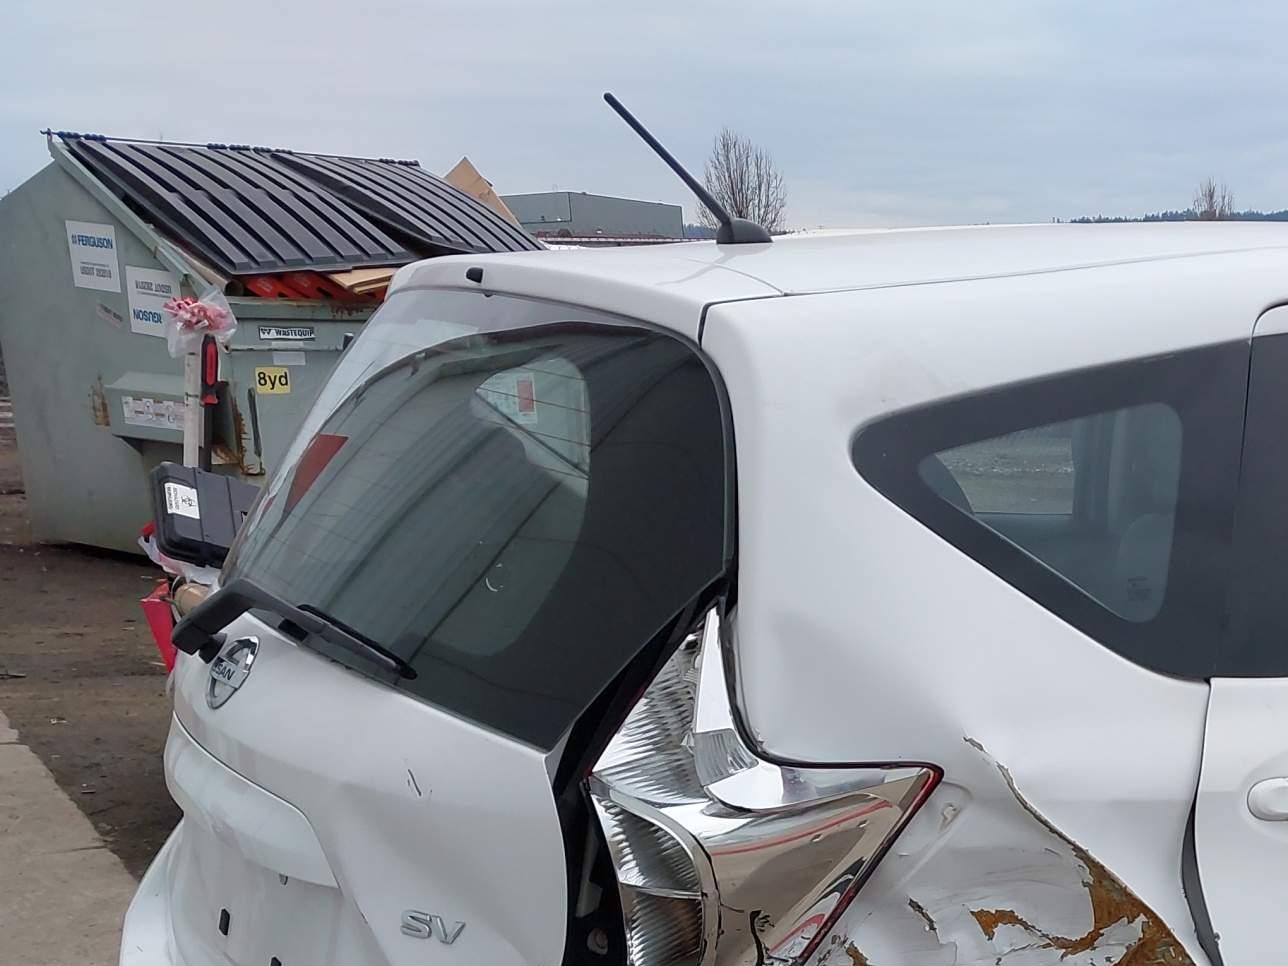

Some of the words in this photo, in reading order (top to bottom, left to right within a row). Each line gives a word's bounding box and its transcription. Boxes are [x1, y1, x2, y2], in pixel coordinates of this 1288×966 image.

[77, 234, 113, 250] FERGUSON
[275, 328, 315, 337] WASTEQUIP
[257, 371, 289, 391] 8yd
[400, 908, 466, 945] SV
